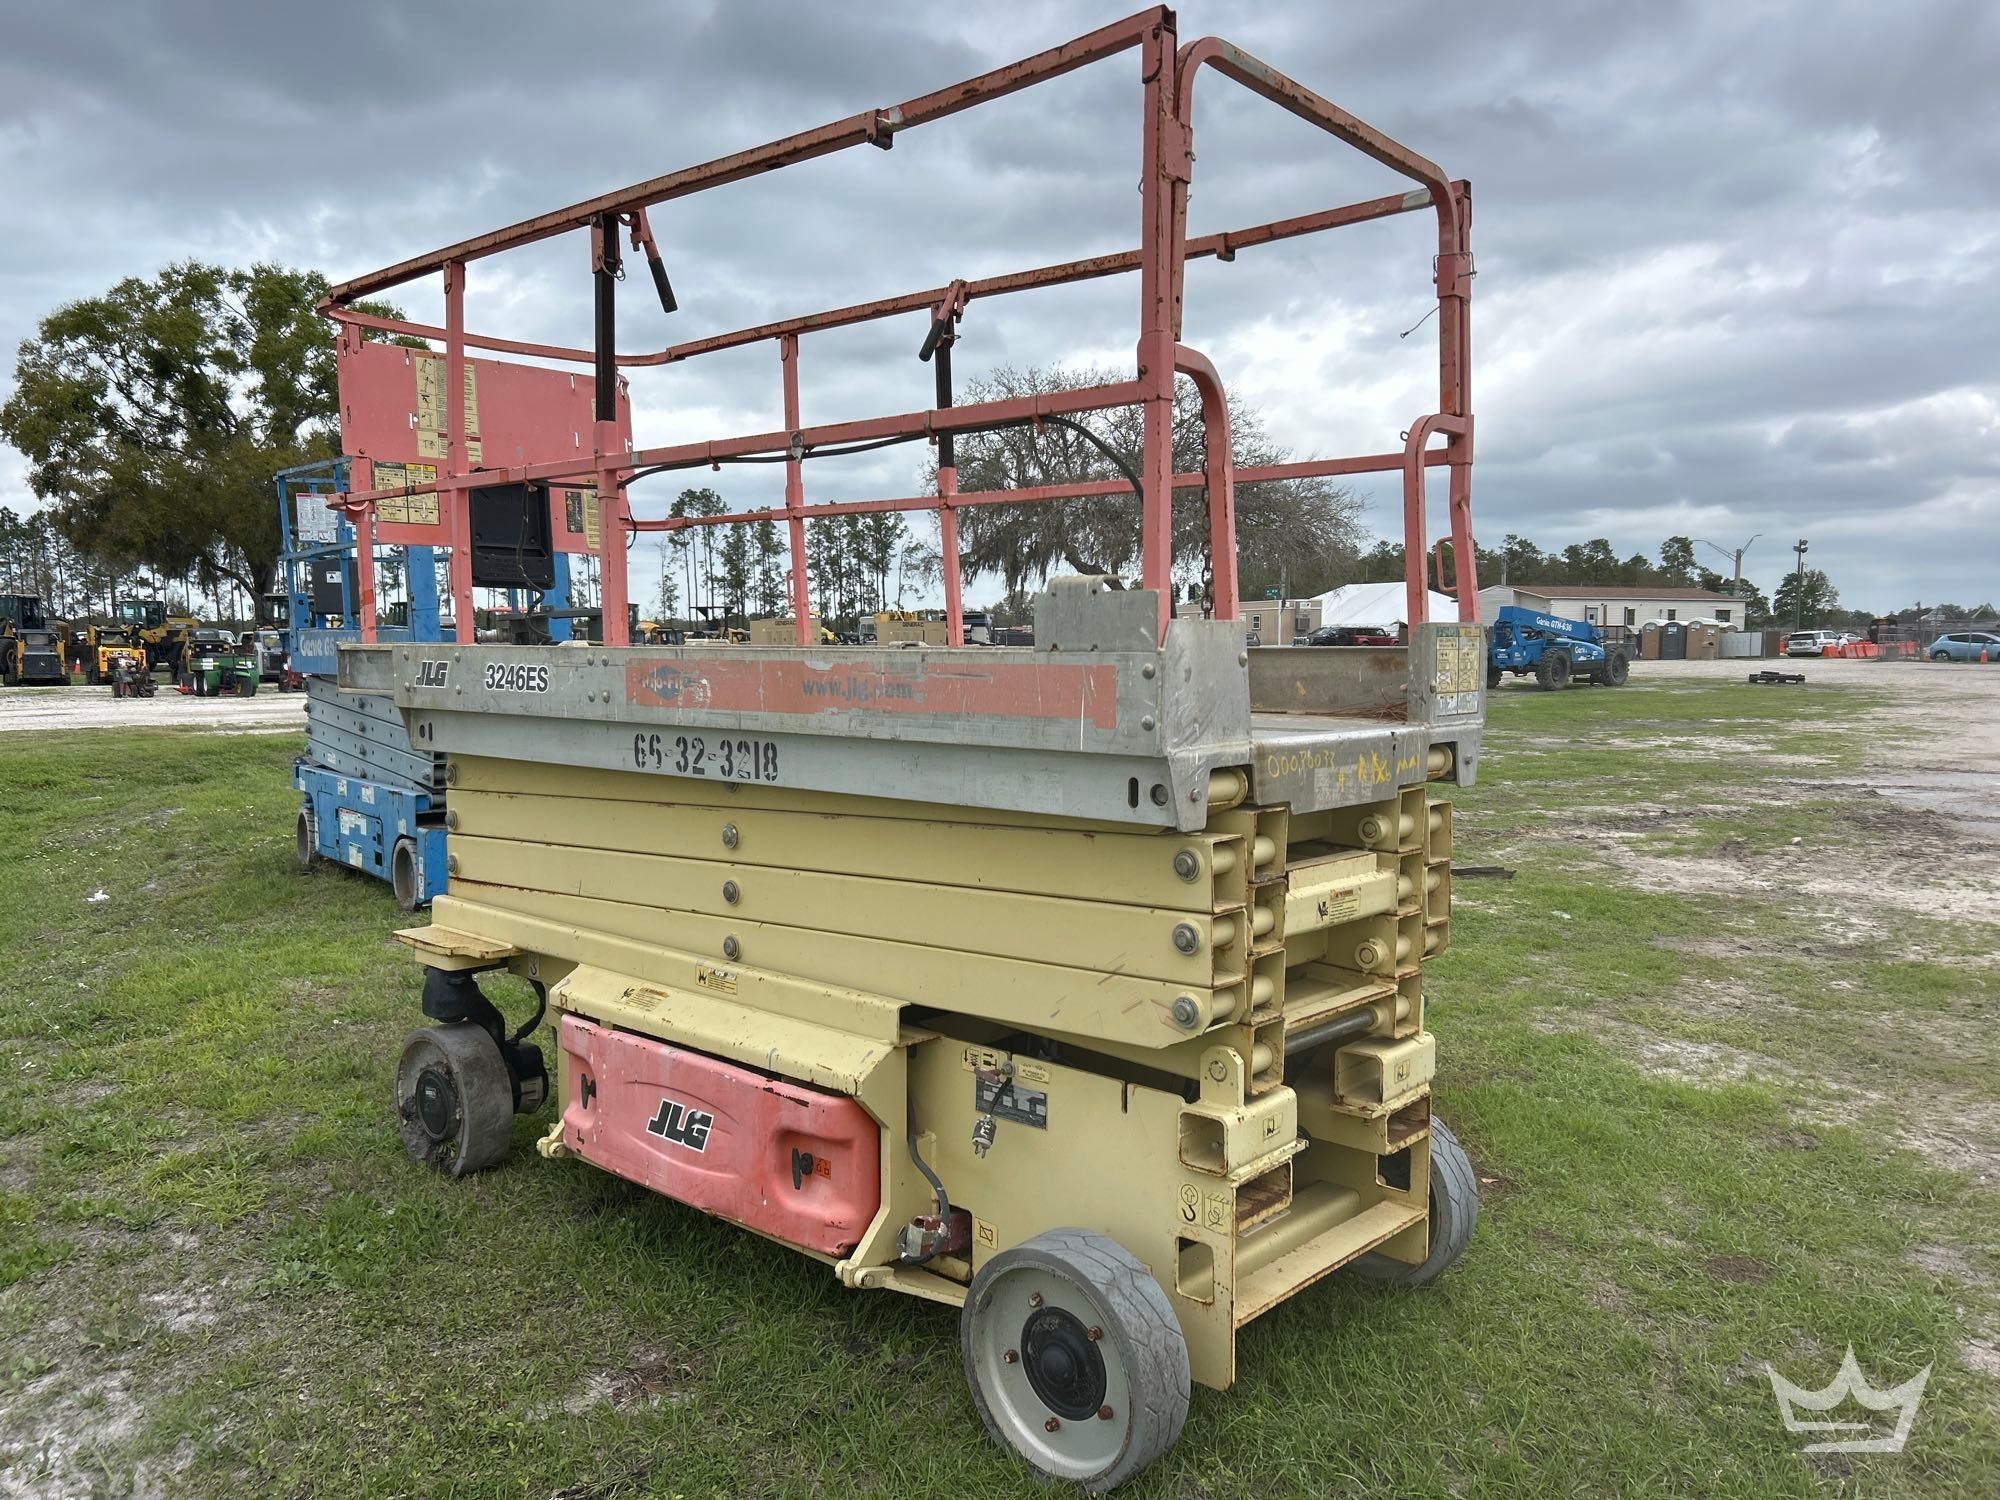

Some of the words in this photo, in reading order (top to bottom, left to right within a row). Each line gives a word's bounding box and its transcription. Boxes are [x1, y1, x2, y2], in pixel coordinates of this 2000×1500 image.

[1536, 616, 1550, 627] Genie
[415, 660, 449, 688] JLG
[485, 663, 549, 693] 3246ES
[647, 1098, 714, 1153] JLG
